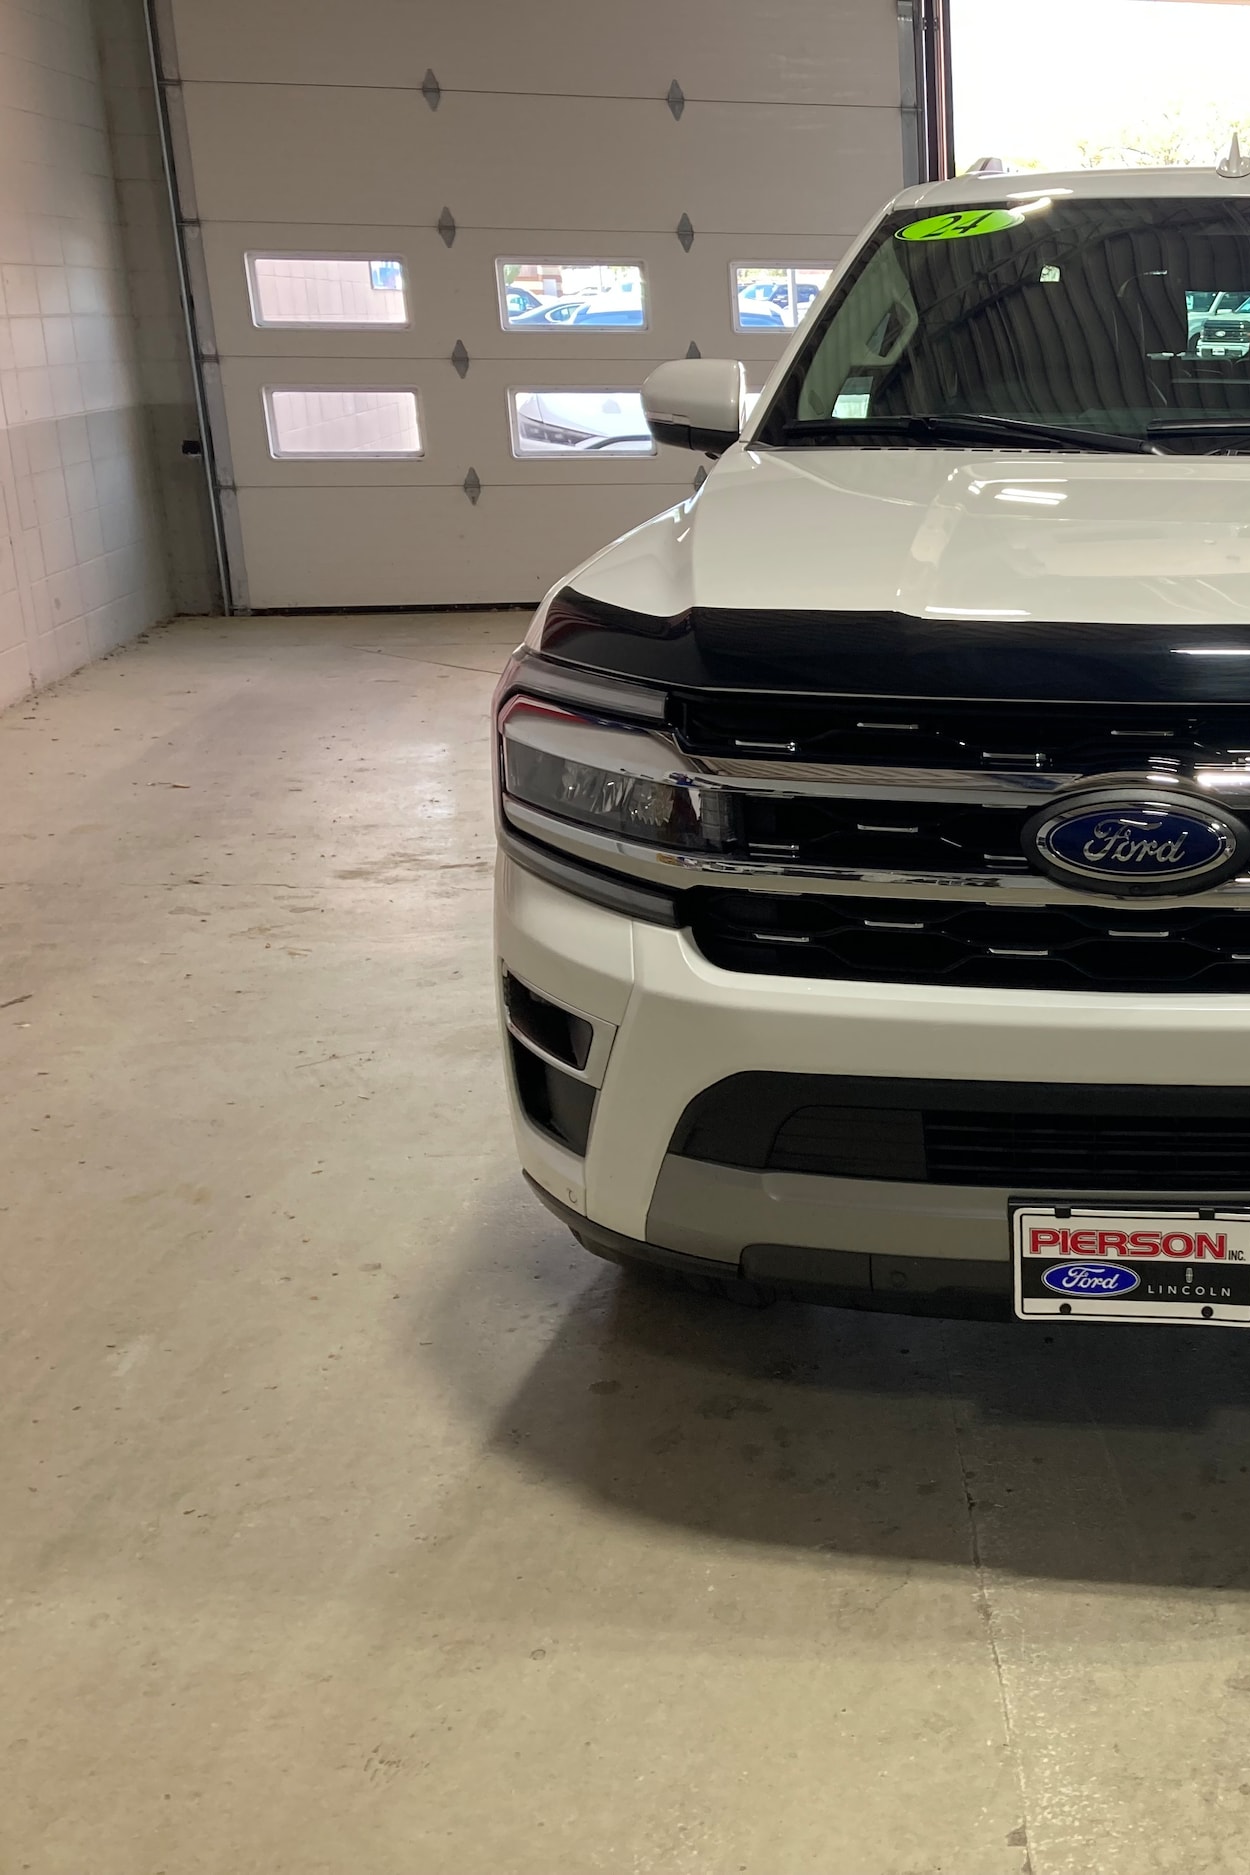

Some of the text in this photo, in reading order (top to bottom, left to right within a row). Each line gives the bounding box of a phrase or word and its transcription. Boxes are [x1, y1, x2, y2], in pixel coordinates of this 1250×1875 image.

[923, 212, 995, 238] 24
[1083, 818, 1189, 863] Ford
[1029, 1228, 1246, 1261] PIERSON INC.
[1062, 1266, 1120, 1290] Ford
[1147, 1285, 1231, 1297] LINCOLN
